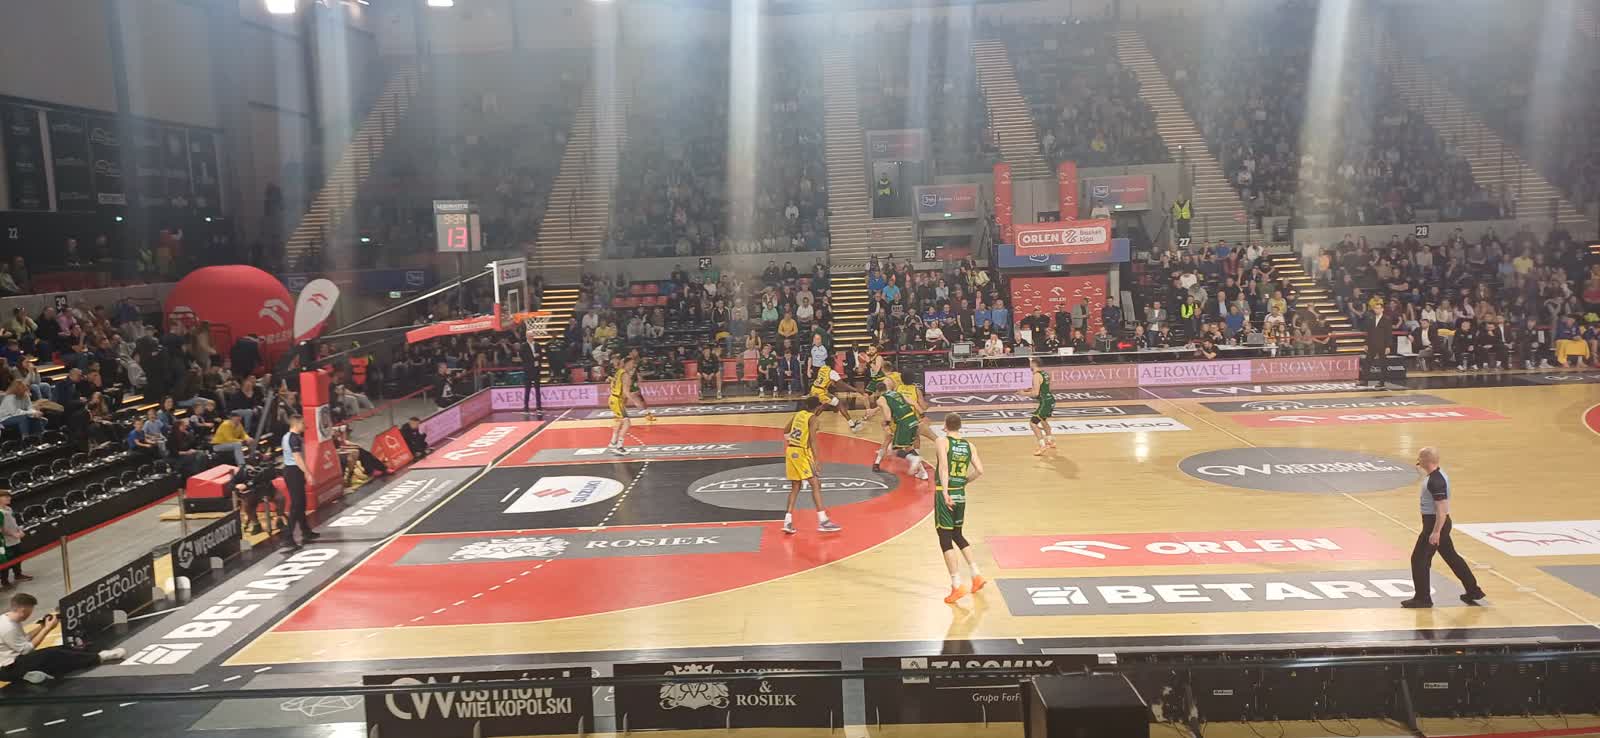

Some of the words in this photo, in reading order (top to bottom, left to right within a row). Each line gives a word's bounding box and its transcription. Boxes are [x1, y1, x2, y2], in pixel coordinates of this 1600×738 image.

[8, 227, 18, 240] 22
[447, 226, 468, 249] 13
[1022, 232, 1059, 244] ORLEN
[1416, 226, 1428, 237] 28
[1179, 237, 1190, 248] 27
[924, 249, 936, 260] 26
[1050, 366, 1138, 382] EROWATCH
[1141, 362, 1242, 380] AEROWATCH
[1258, 358, 1360, 376] AEROWATCH
[927, 370, 1025, 387] AEROWATCH
[1084, 418, 1174, 430] Pekao
[1338, 410, 1465, 423] ORLEN
[950, 461, 967, 477] 13
[351, 479, 428, 517] TASOMIX
[570, 480, 603, 504] SUZUKI
[584, 535, 720, 550] ROSIEK
[1145, 537, 1343, 557] ORLEN
[66, 564, 152, 632] graficolor
[162, 548, 340, 640] BETARD
[1096, 577, 1437, 606] BETARD
[759, 680, 772, 693] &
[735, 693, 798, 707] ROSIEK
[972, 692, 1000, 704] Grupa
[455, 697, 572, 719] WIELKOPOLSKI
